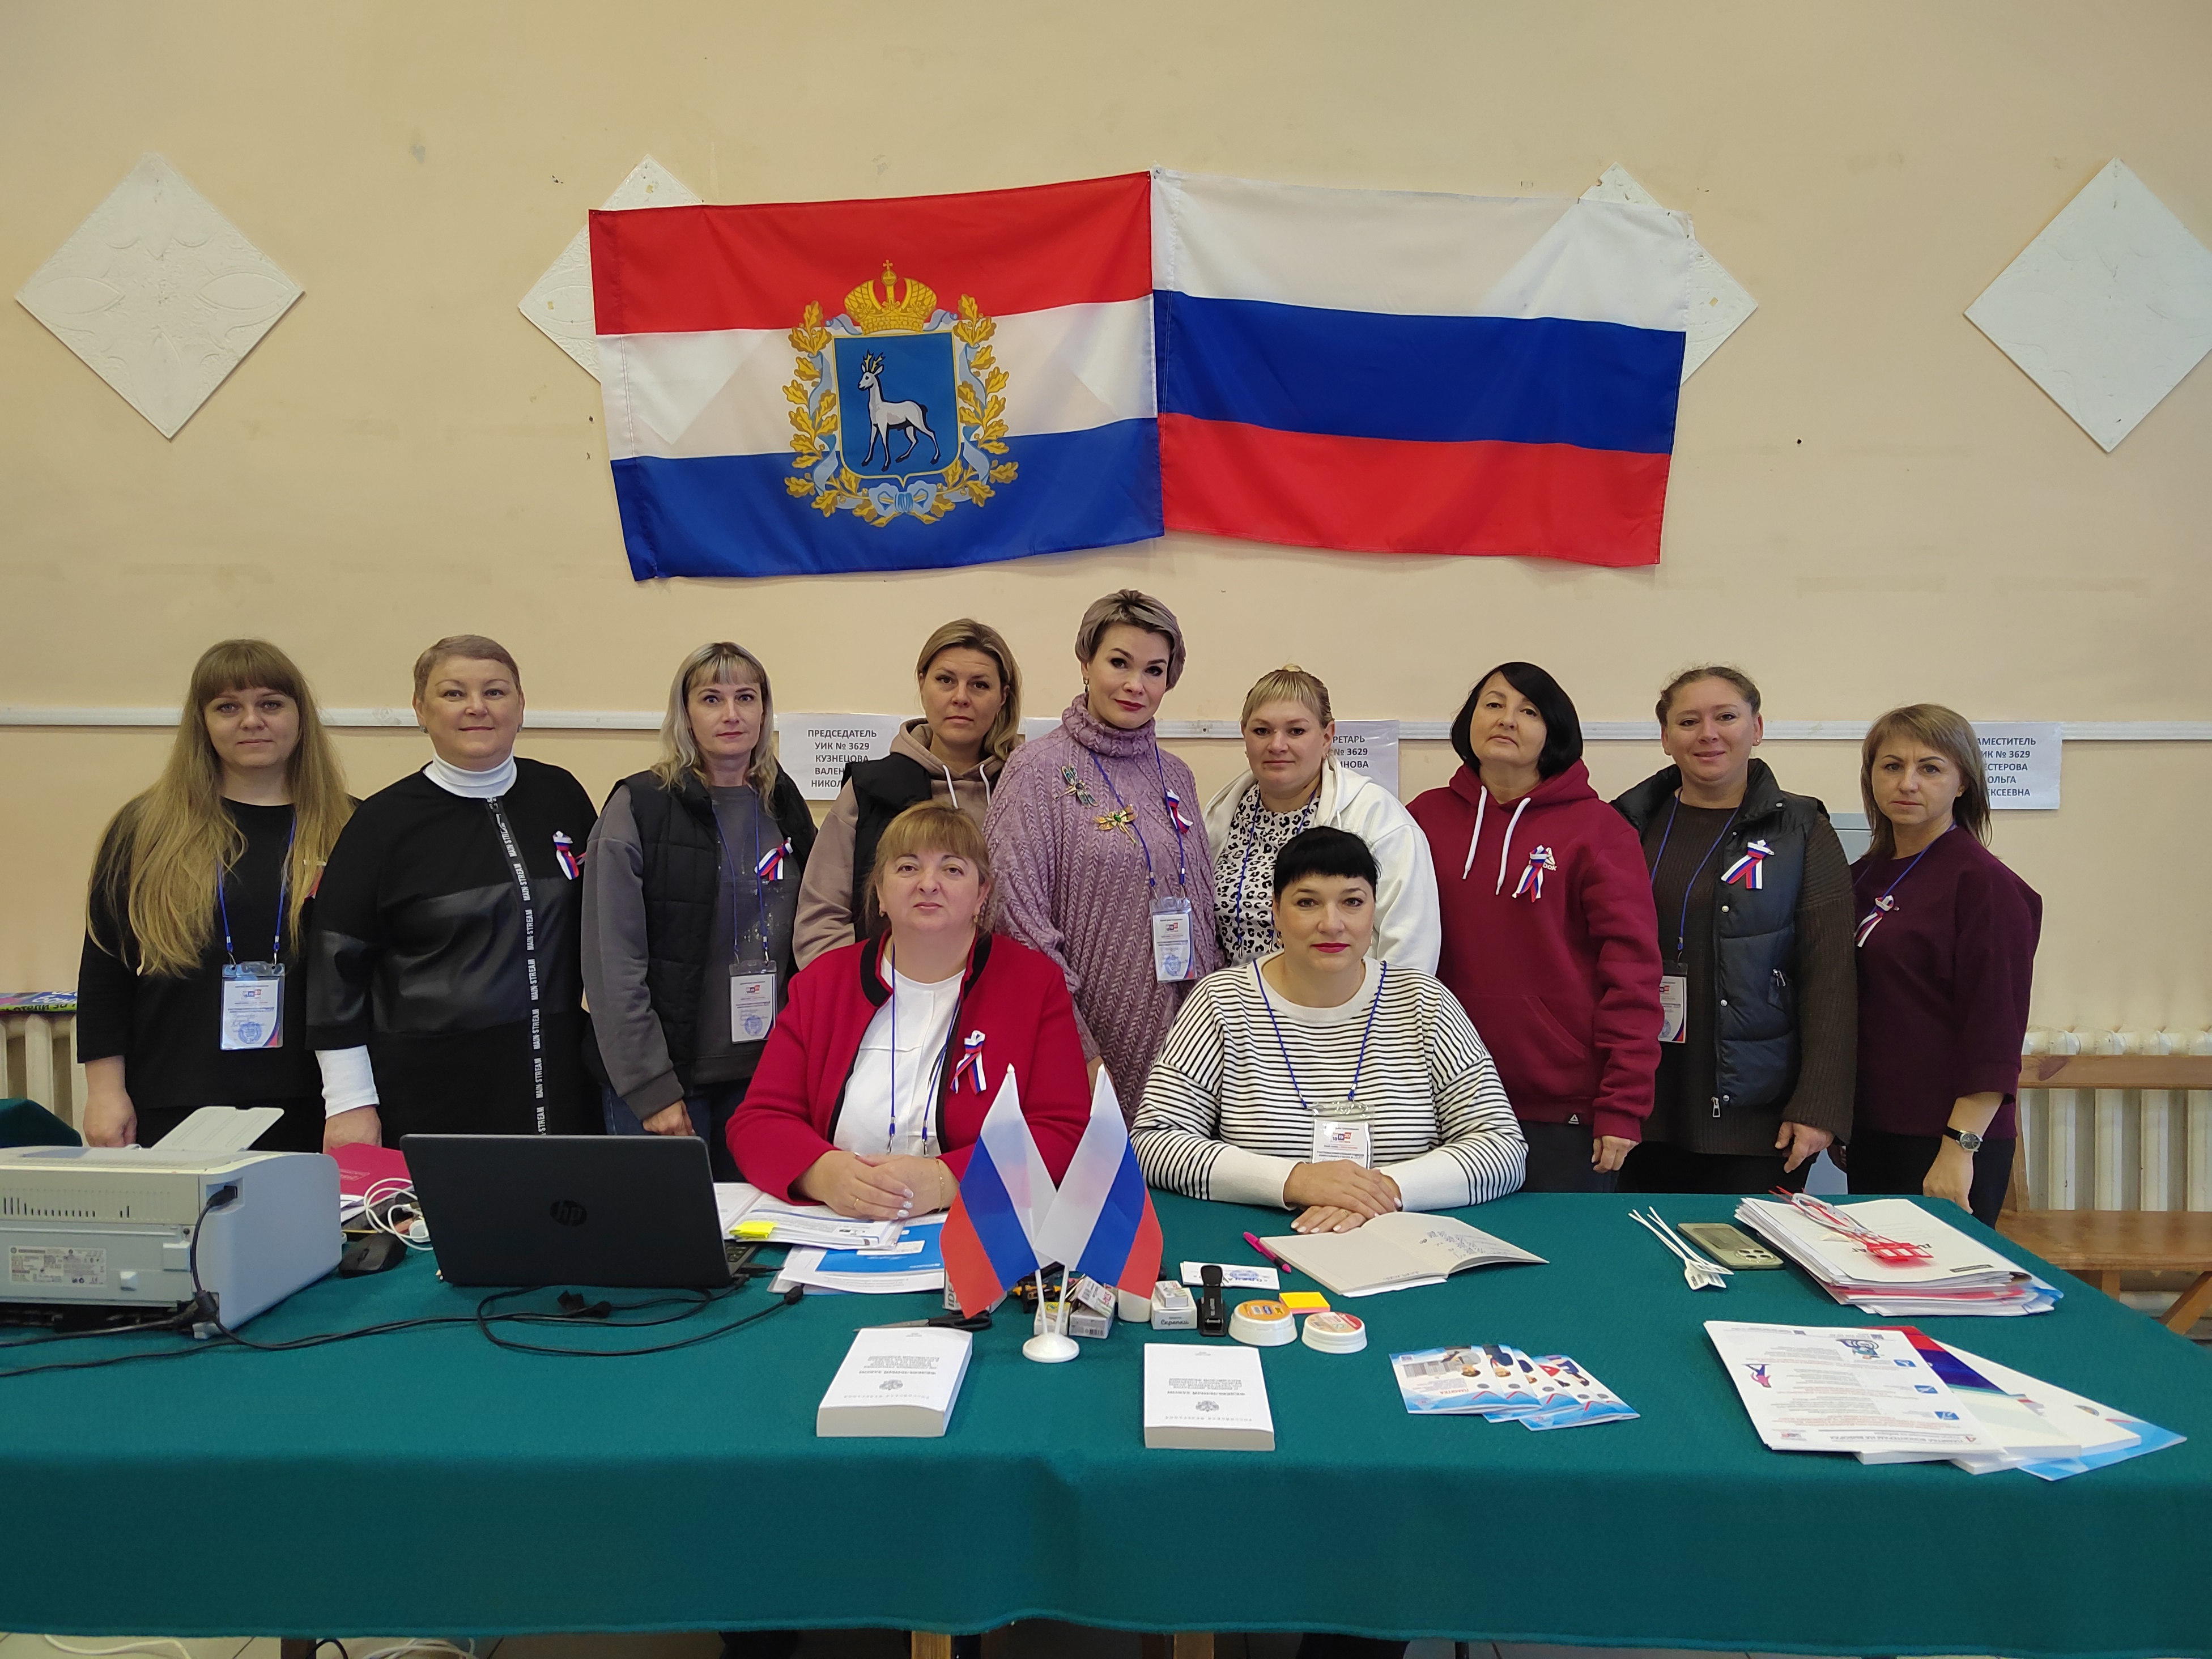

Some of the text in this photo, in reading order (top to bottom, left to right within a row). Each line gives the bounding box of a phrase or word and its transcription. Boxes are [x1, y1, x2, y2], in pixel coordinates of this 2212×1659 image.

[807, 729, 877, 739] ПРЕДСЕДАТЕЛЬ
[814, 742, 833, 750] УИК
[848, 742, 870, 750] 3629
[815, 755, 869, 763] КУЗНЕЦОВА
